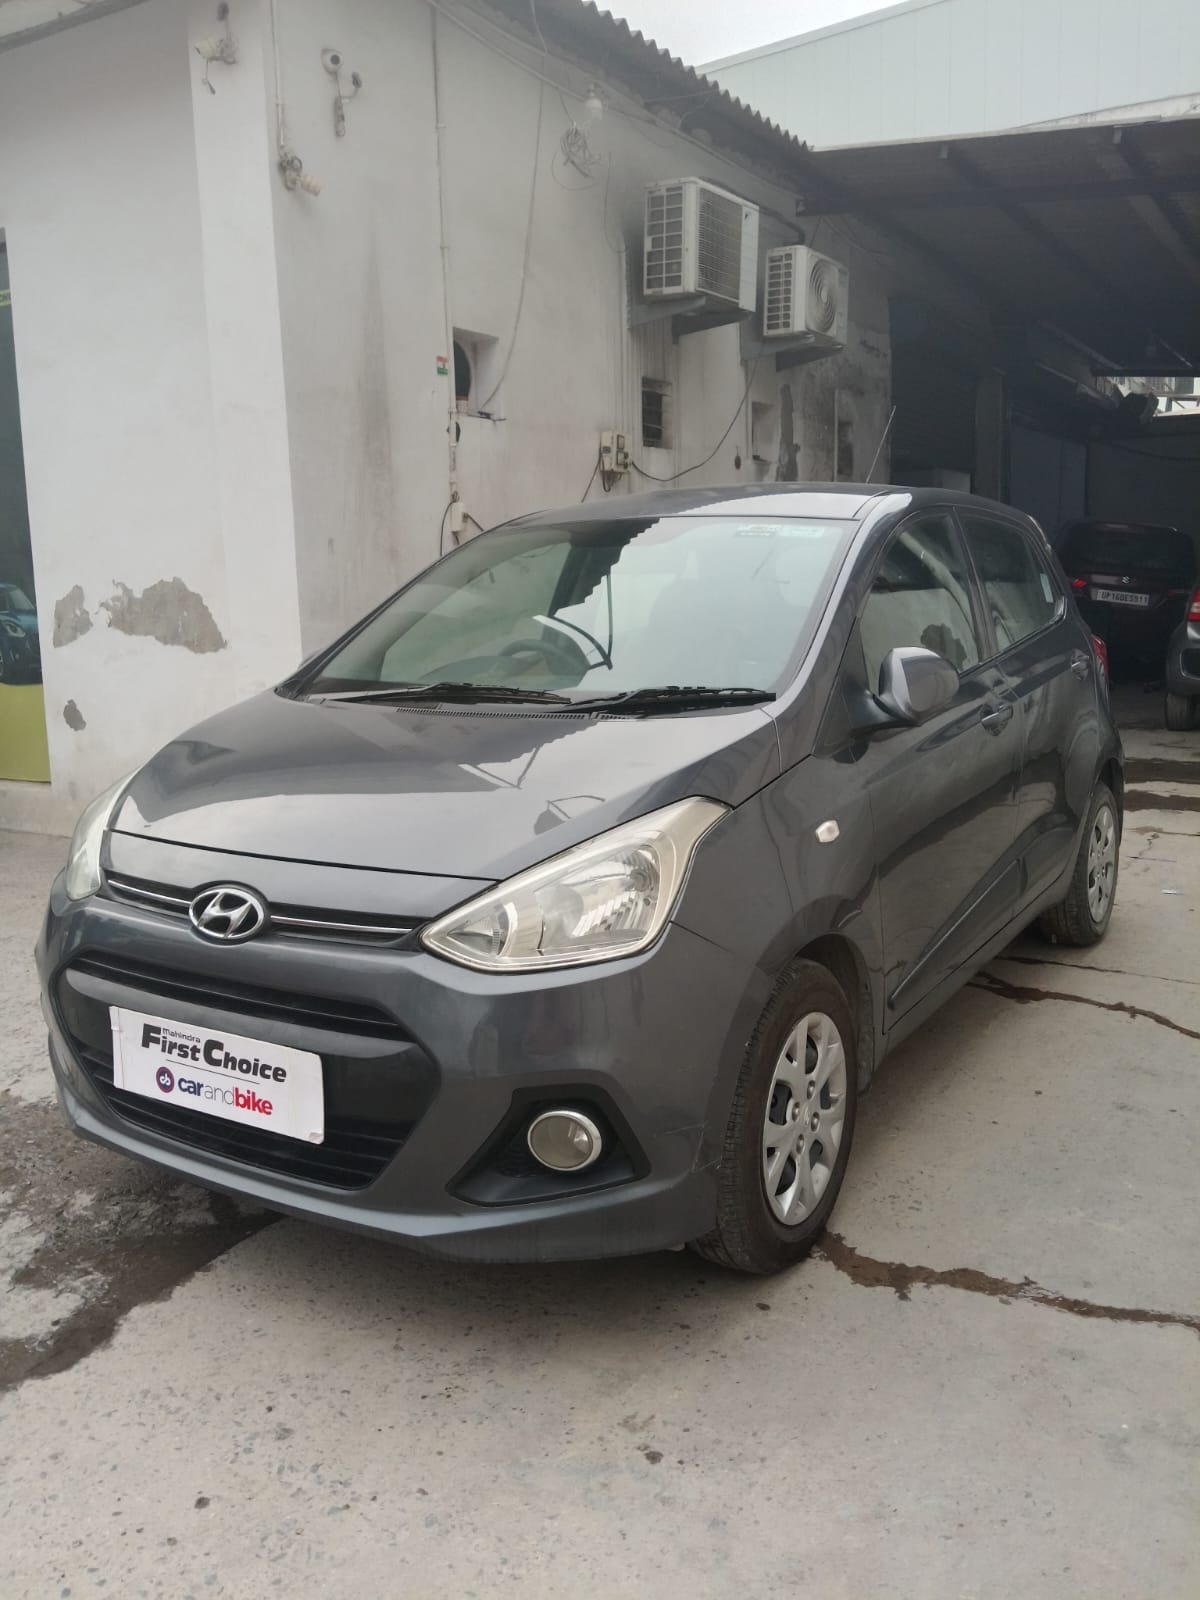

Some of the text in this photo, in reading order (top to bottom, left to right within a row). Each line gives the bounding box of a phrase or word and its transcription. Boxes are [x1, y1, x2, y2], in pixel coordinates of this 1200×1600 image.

[141, 1023, 287, 1083] First Choice
[178, 1076, 273, 1115] carandbike
